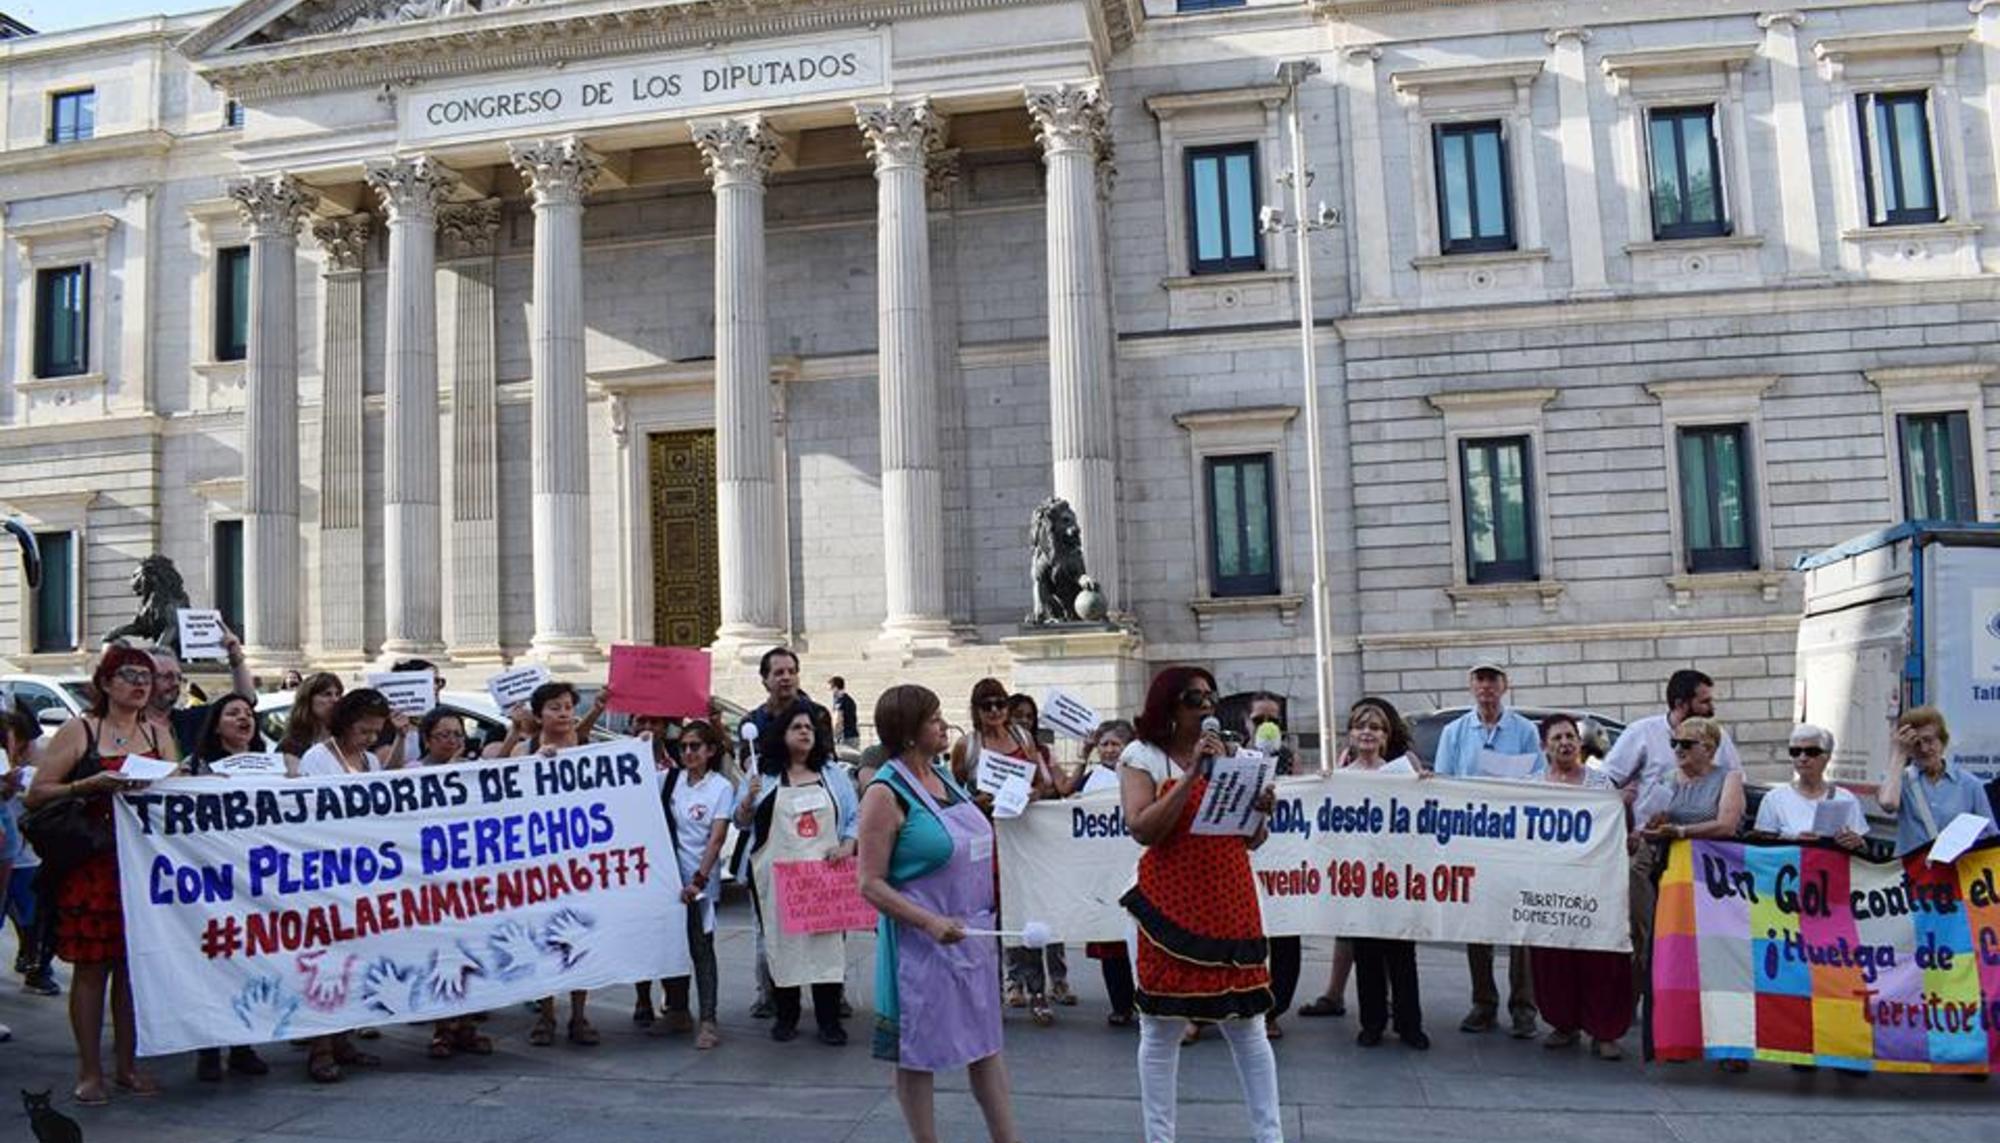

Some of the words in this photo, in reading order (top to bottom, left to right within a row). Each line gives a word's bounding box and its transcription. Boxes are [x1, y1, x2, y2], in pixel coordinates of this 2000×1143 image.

[427, 88, 562, 125] CONGRESO
[582, 82, 613, 106] DE
[633, 75, 681, 100] LOS
[703, 53, 857, 92] DIPUTADOS
[125, 771, 467, 835] TRABAJADORAS
[479, 765, 523, 804] DE
[535, 753, 642, 796] HOGAR
[1317, 797, 1384, 834] desde
[1390, 798, 1411, 833] la
[1417, 799, 1517, 845] dignidad
[1524, 806, 1592, 843] TODO
[150, 854, 233, 904] CON
[249, 841, 403, 897] PLENOS
[421, 803, 614, 875] DERECHOS
[1327, 859, 1367, 898] 189
[1372, 862, 1399, 899] de
[1405, 864, 1426, 901] la
[1432, 864, 1476, 903] OIT
[1702, 853, 1758, 904] Un
[1775, 864, 1831, 919] Gol
[1850, 873, 1960, 920] contra
[1970, 867, 2000, 908] el
[202, 846, 649, 959] #NOALAENMIENDA6777
[1512, 907, 1591, 929] DOMESTICO
[1764, 928, 1896, 983] ¡Huelga
[1915, 931, 1955, 970] de
